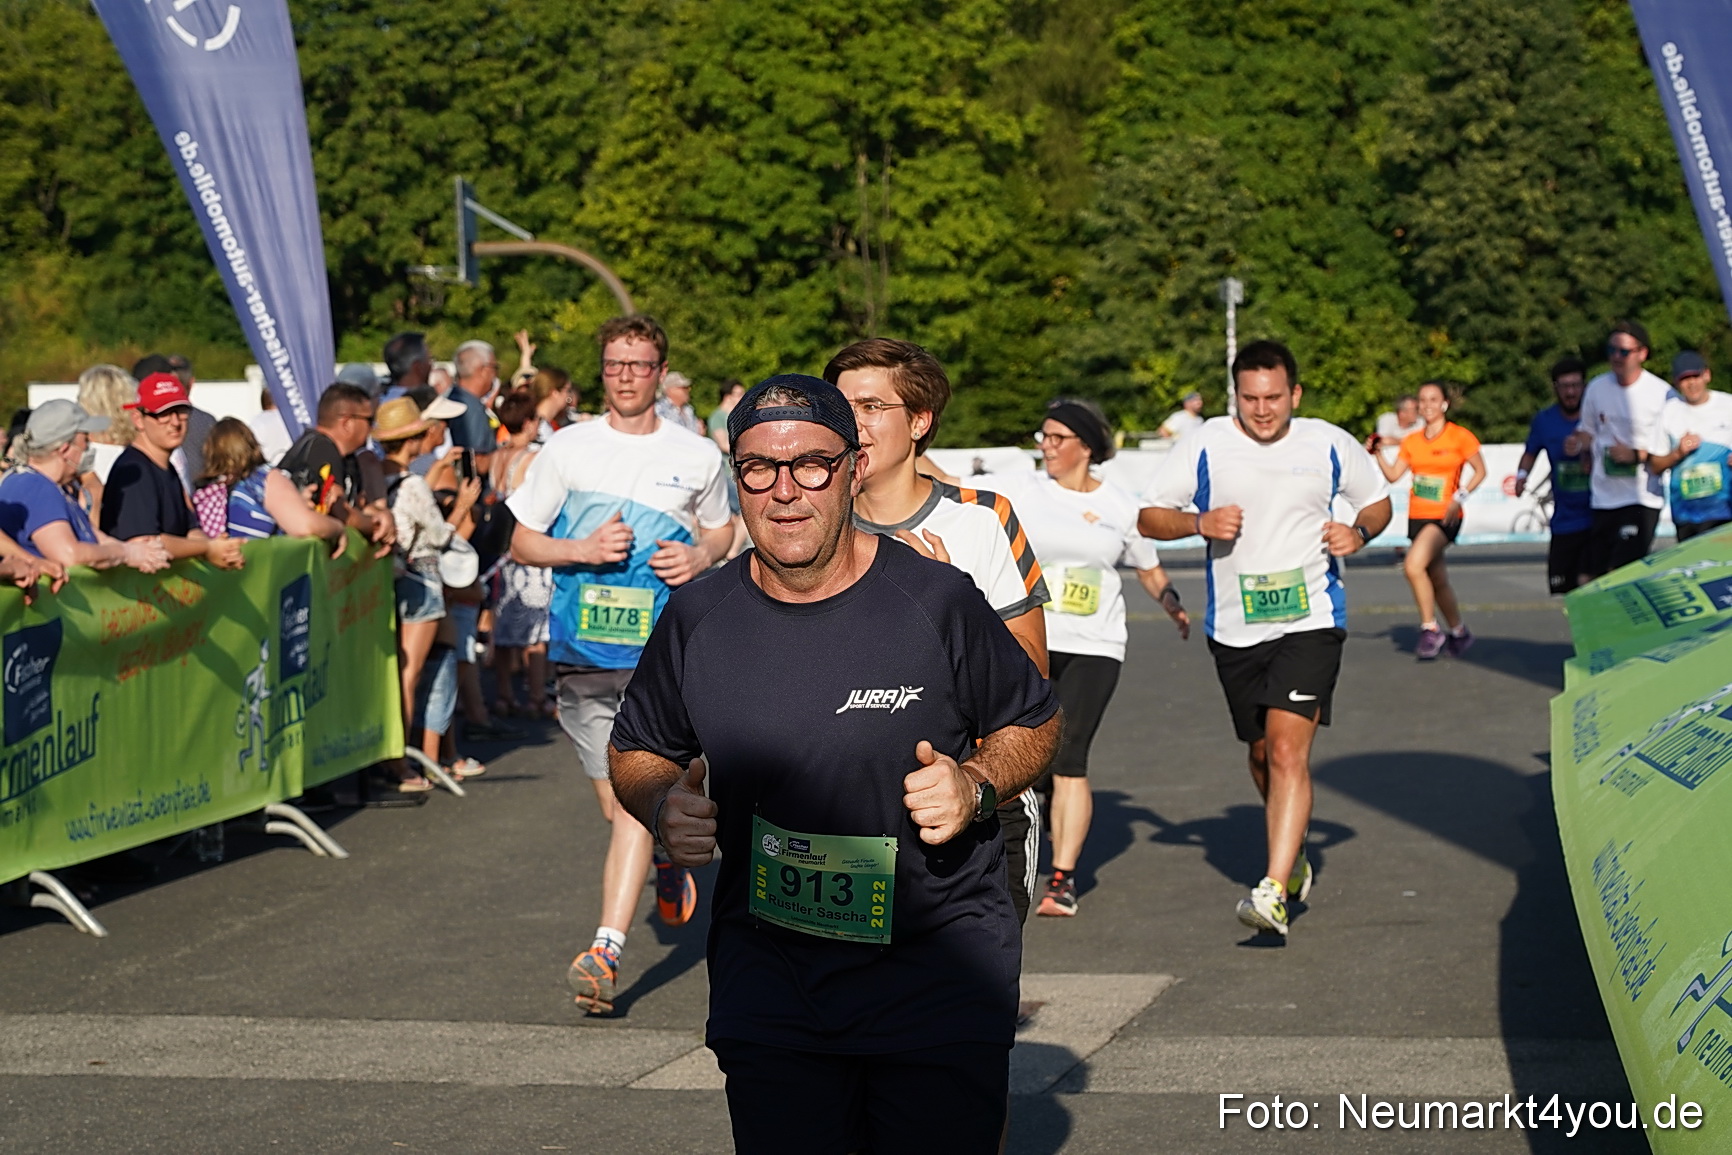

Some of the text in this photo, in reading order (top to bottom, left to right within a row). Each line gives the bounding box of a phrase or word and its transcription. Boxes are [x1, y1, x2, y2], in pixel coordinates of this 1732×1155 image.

[1256, 588, 1291, 606] 307
[591, 605, 639, 625] 1178
[835, 689, 899, 714] JURA
[781, 849, 828, 861] Firmenlauf
[756, 865, 767, 900] RUN
[780, 865, 854, 907] 913
[768, 893, 867, 923] Rustler Sascha
[871, 880, 887, 928] 2022
